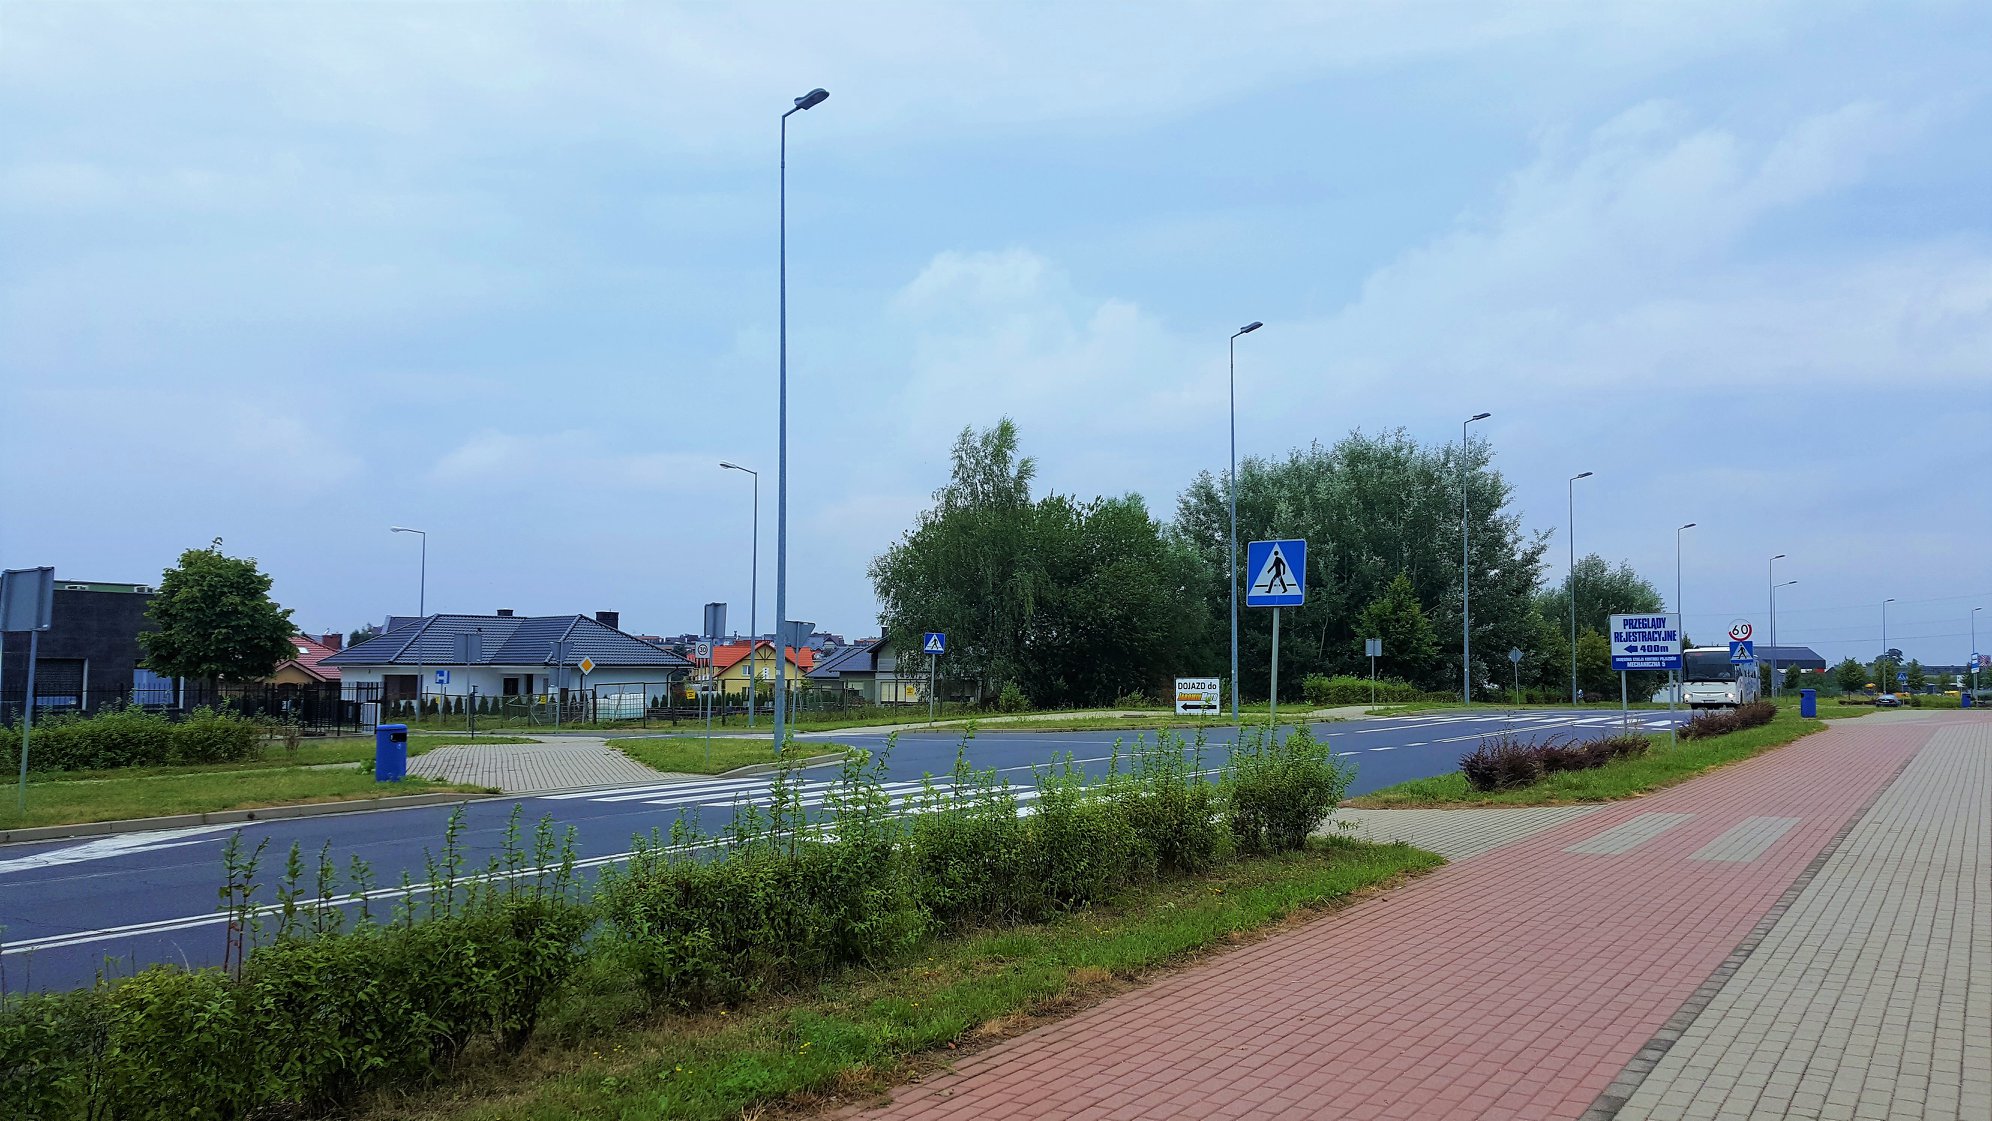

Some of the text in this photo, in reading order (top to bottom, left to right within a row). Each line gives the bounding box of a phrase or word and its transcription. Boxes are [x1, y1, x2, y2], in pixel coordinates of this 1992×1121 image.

[1623, 617, 1666, 630] PRZEGLĄDY
[1732, 624, 1748, 635] 60
[1614, 630, 1677, 643] REJESTRACYJNE
[1640, 645, 1669, 653] 400m
[1178, 681, 1217, 690] DOJAZD do
